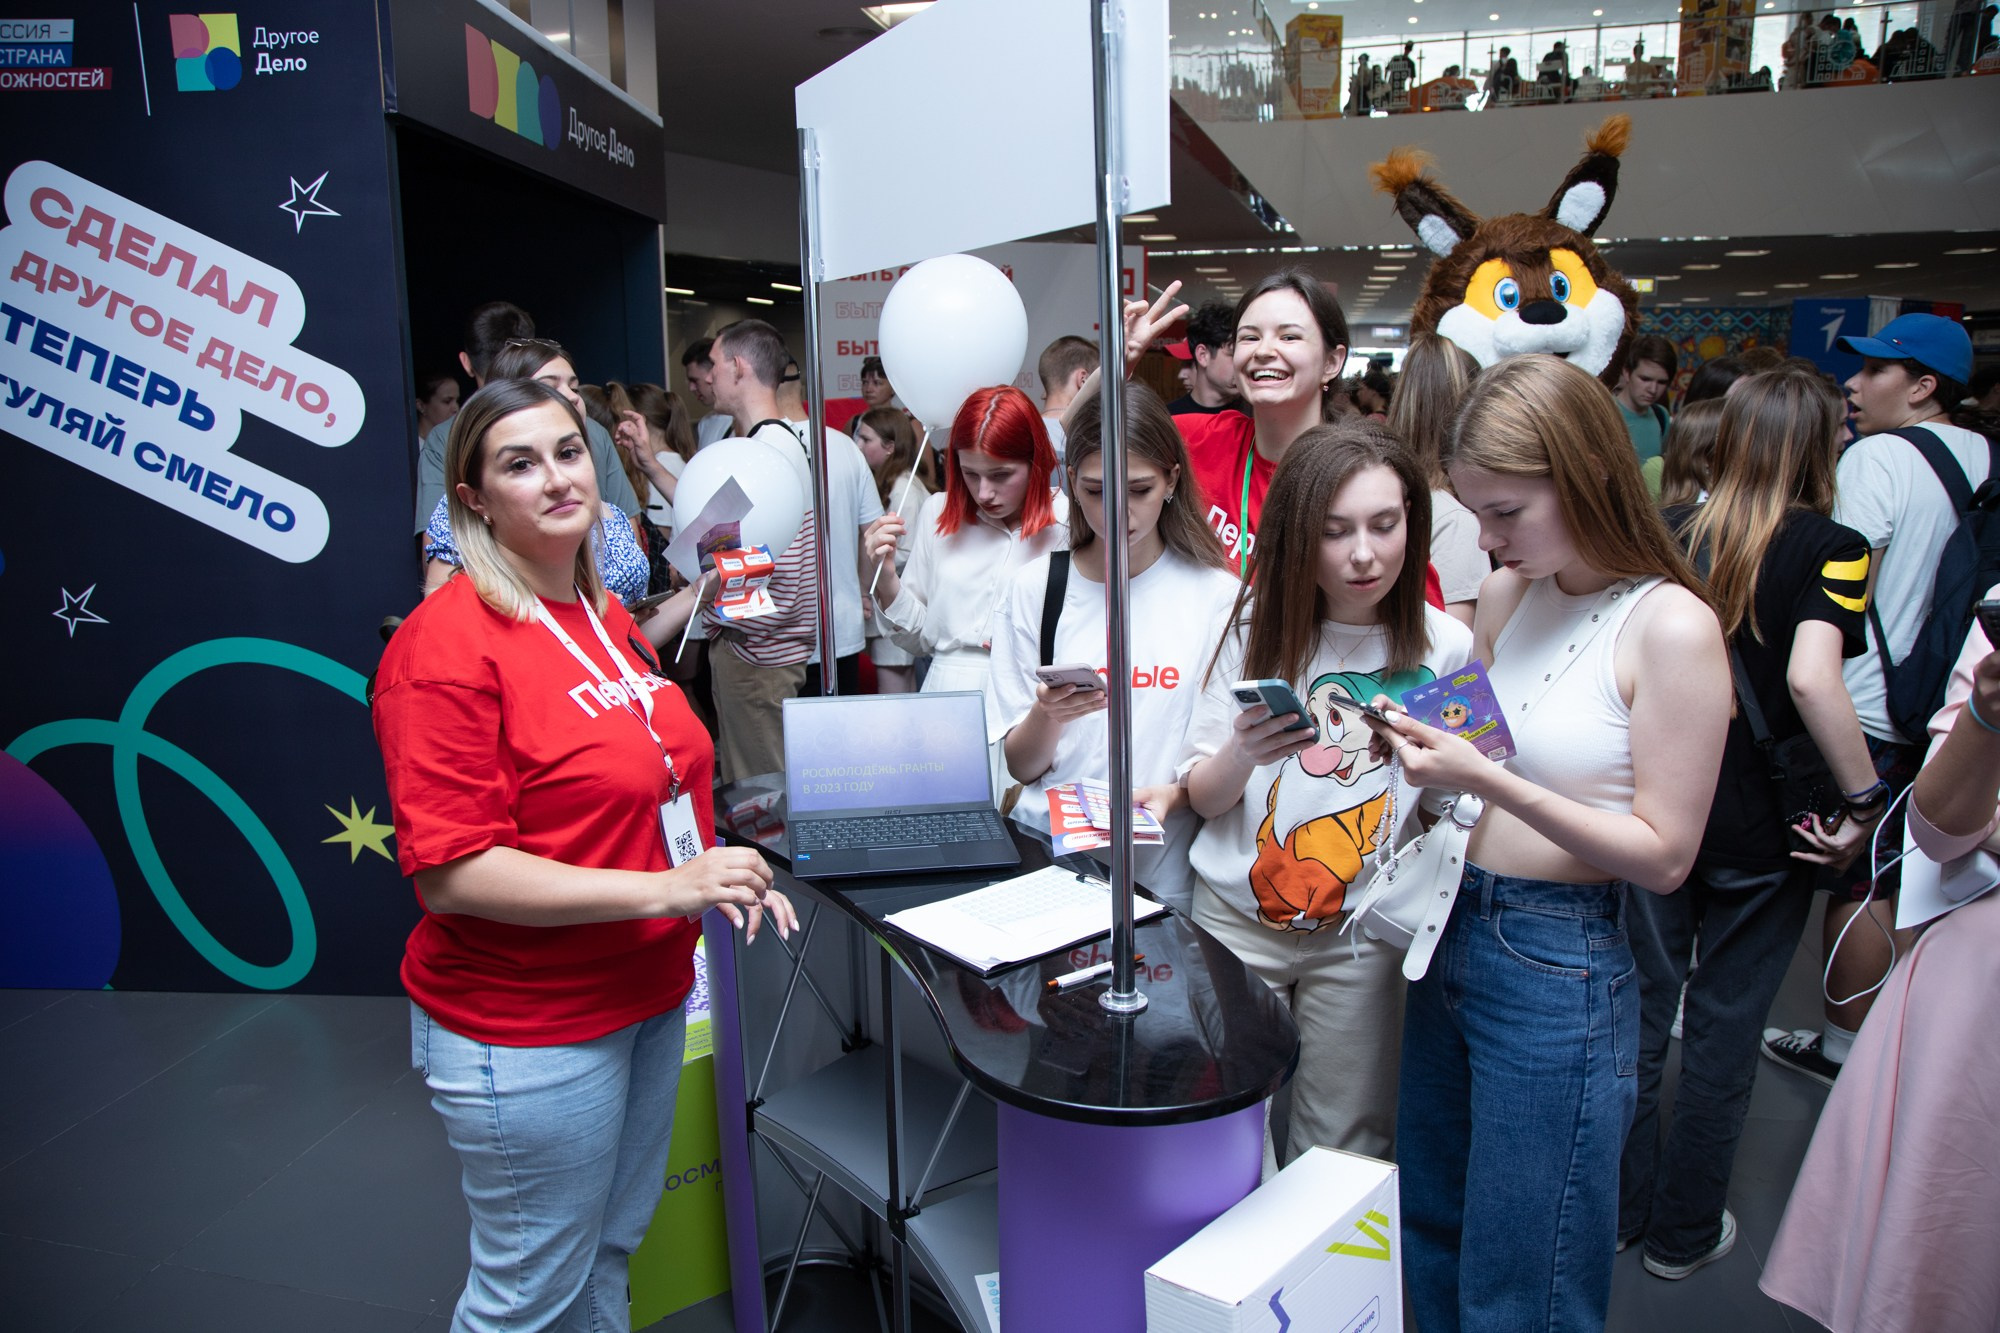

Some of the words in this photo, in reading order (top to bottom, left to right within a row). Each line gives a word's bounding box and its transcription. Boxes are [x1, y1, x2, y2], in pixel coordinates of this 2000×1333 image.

[253, 27, 319, 49] Другое
[0, 69, 104, 88] ОЖНОСТЕЙ
[255, 53, 307, 75] Дело
[568, 106, 607, 154] Другое
[609, 127, 634, 168] Дело
[30, 187, 279, 328] СДЕЛАЛ
[835, 301, 882, 319] БЫТ
[10, 250, 195, 354] ДРУГОЕ
[195, 336, 336, 428] ДЕЛО,
[837, 340, 879, 356] БЫТ
[0, 303, 215, 431] ТЕПЕРЬ
[133, 441, 296, 533] СМЕЛО
[1207, 504, 1256, 559] Пер
[803, 783, 811, 794] В
[814, 783, 841, 794] 2023
[844, 781, 875, 792] ГОДУ
